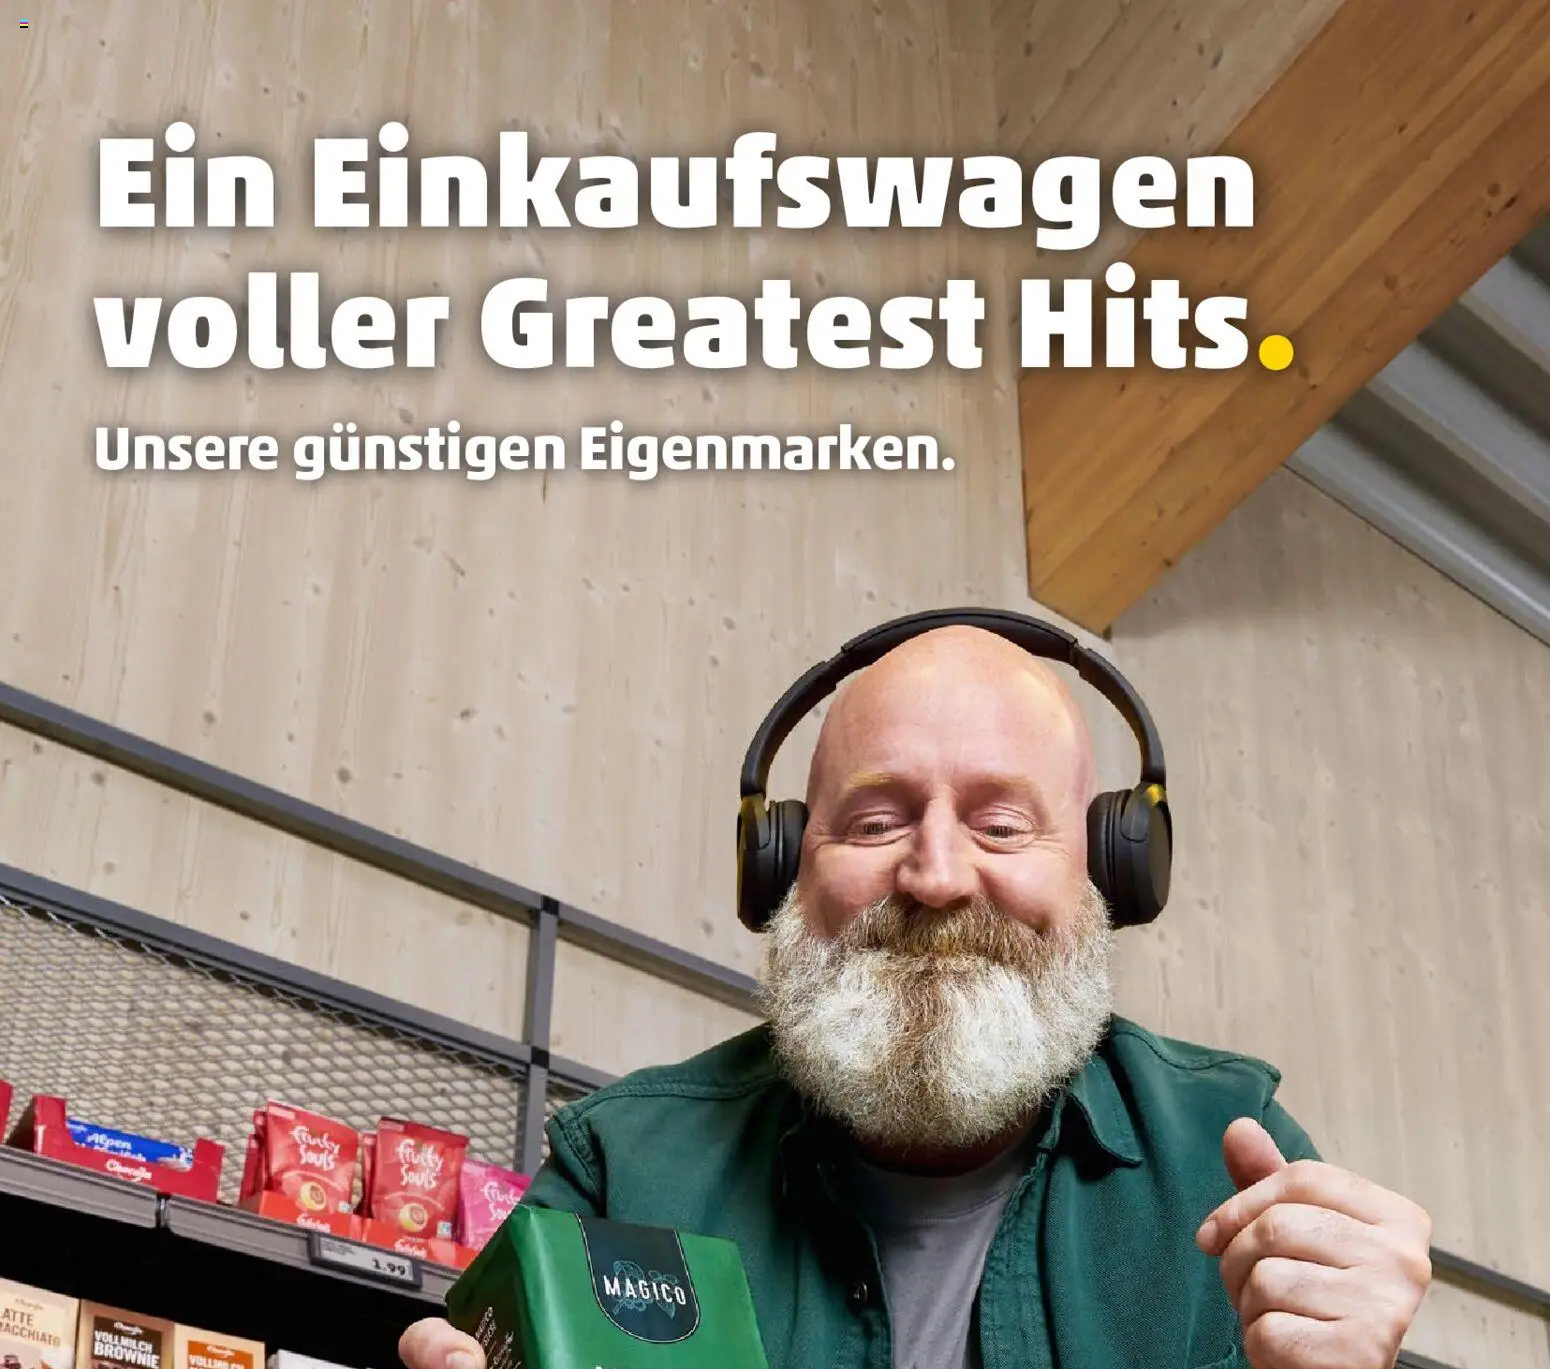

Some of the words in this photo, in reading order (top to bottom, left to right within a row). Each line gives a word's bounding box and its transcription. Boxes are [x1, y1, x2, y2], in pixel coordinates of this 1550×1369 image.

[371, 1256, 406, 1276] 1.99
[603, 1274, 687, 1306] MAGICO
[0, 1307, 35, 1327] ATTE
[94, 1329, 153, 1354] VOLLMILCH
